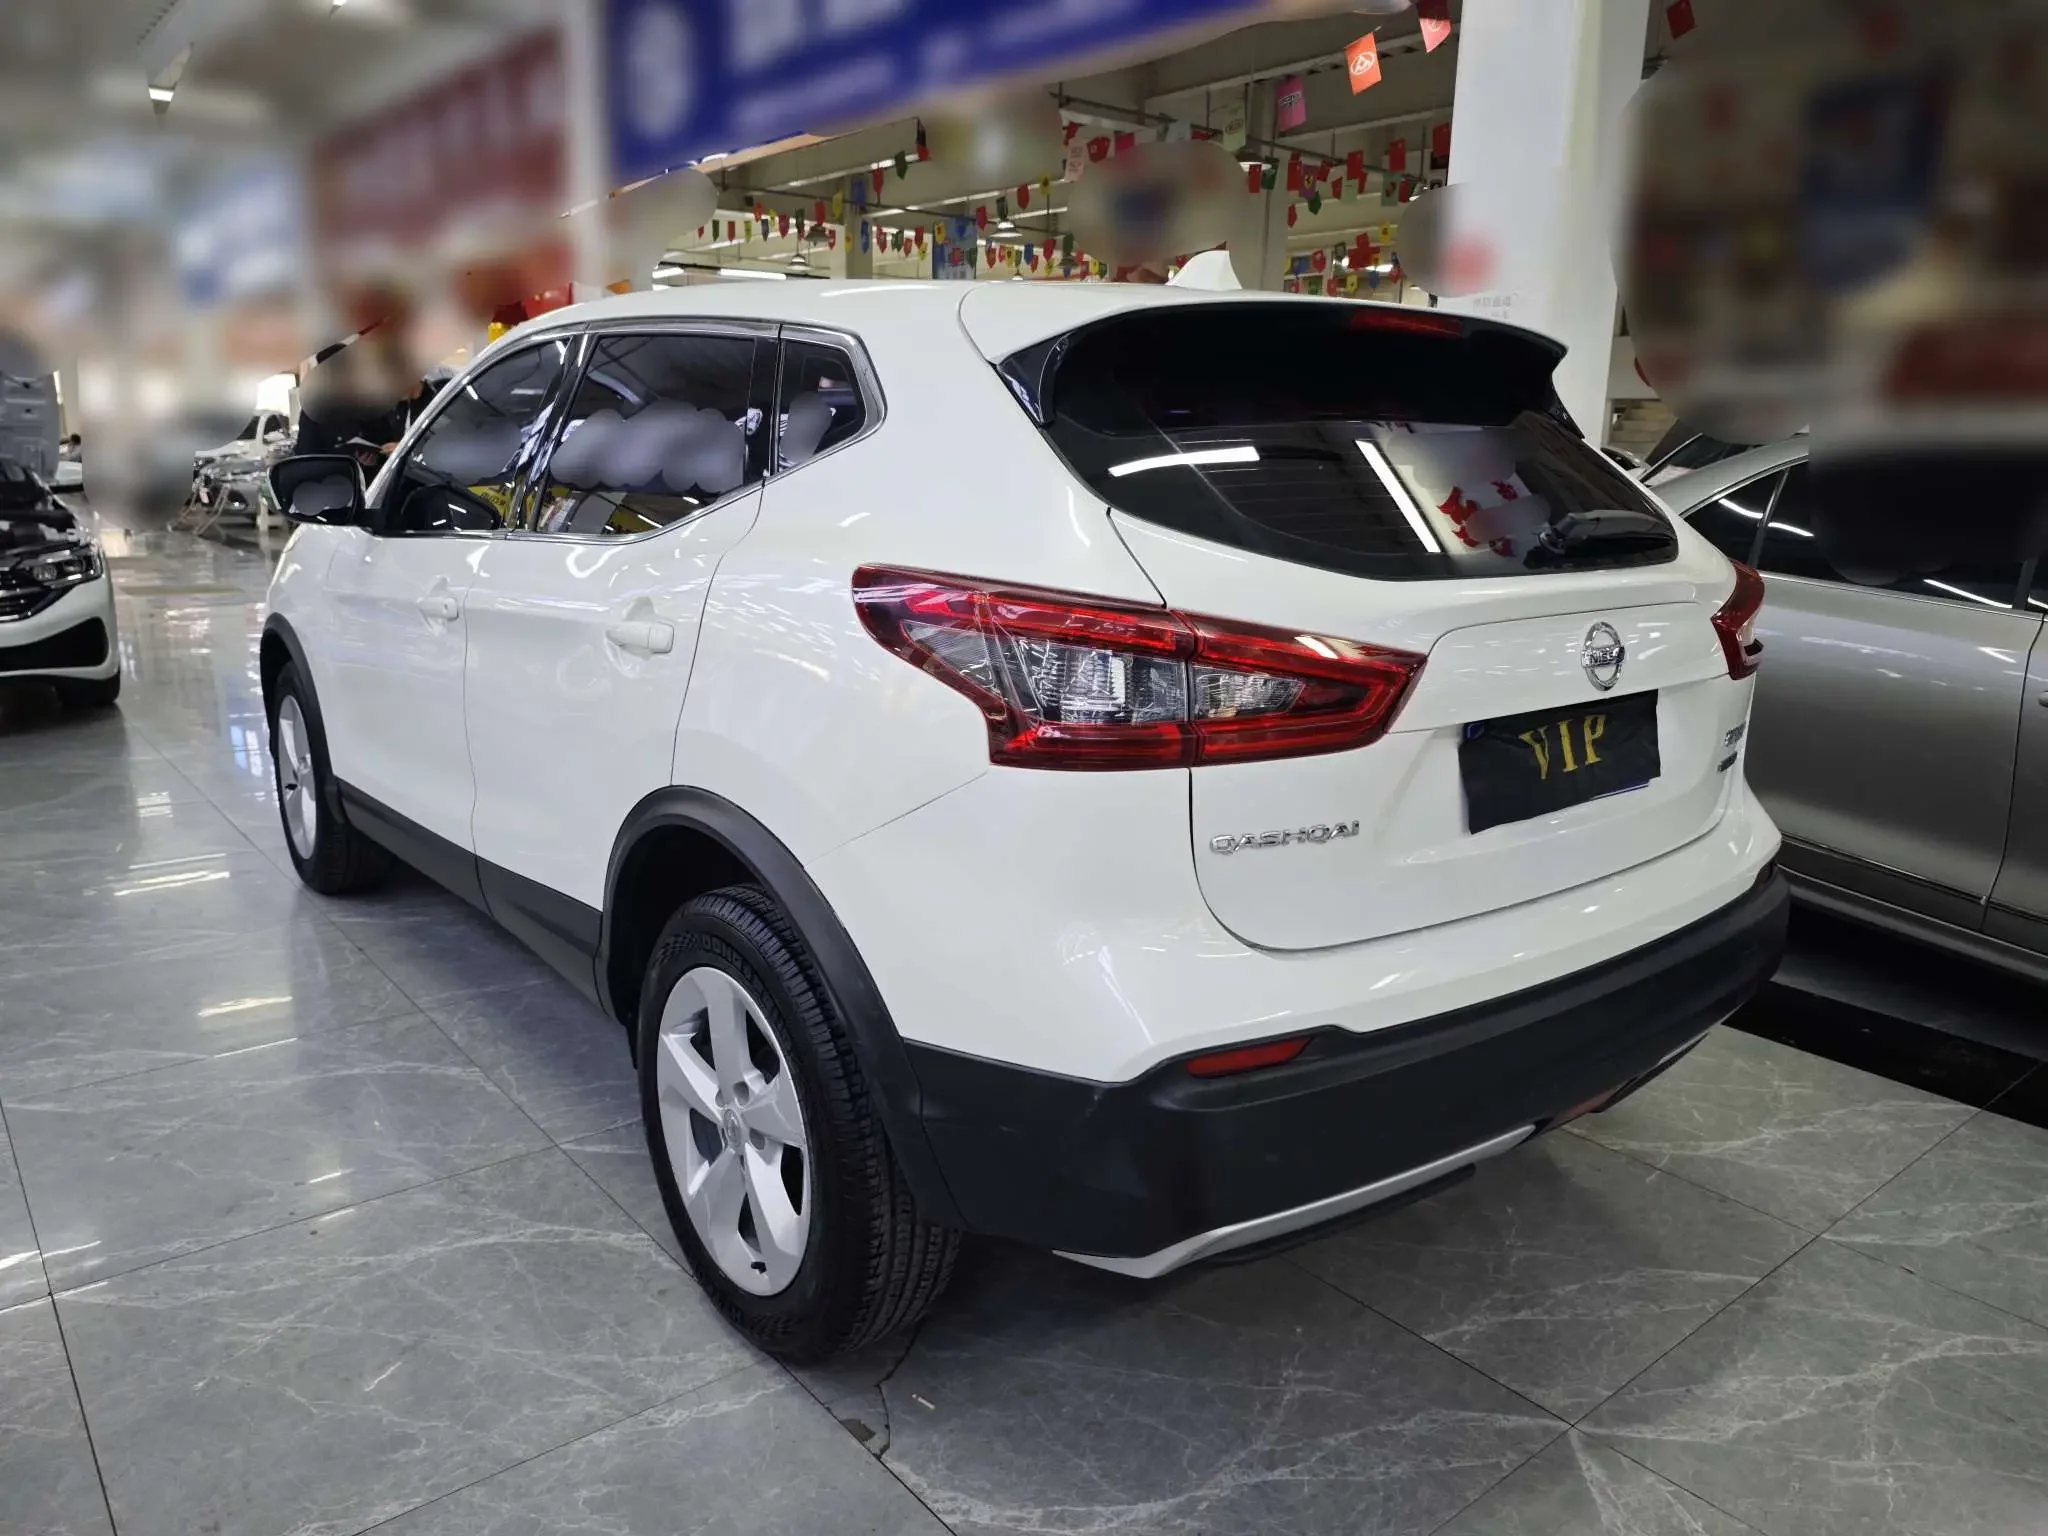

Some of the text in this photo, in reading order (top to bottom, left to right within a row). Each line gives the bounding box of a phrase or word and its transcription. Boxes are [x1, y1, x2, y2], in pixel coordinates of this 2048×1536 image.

[1586, 646, 1623, 667] NISS
[1518, 714, 1607, 780] VIP
[1210, 820, 1360, 855] QASHQAI
